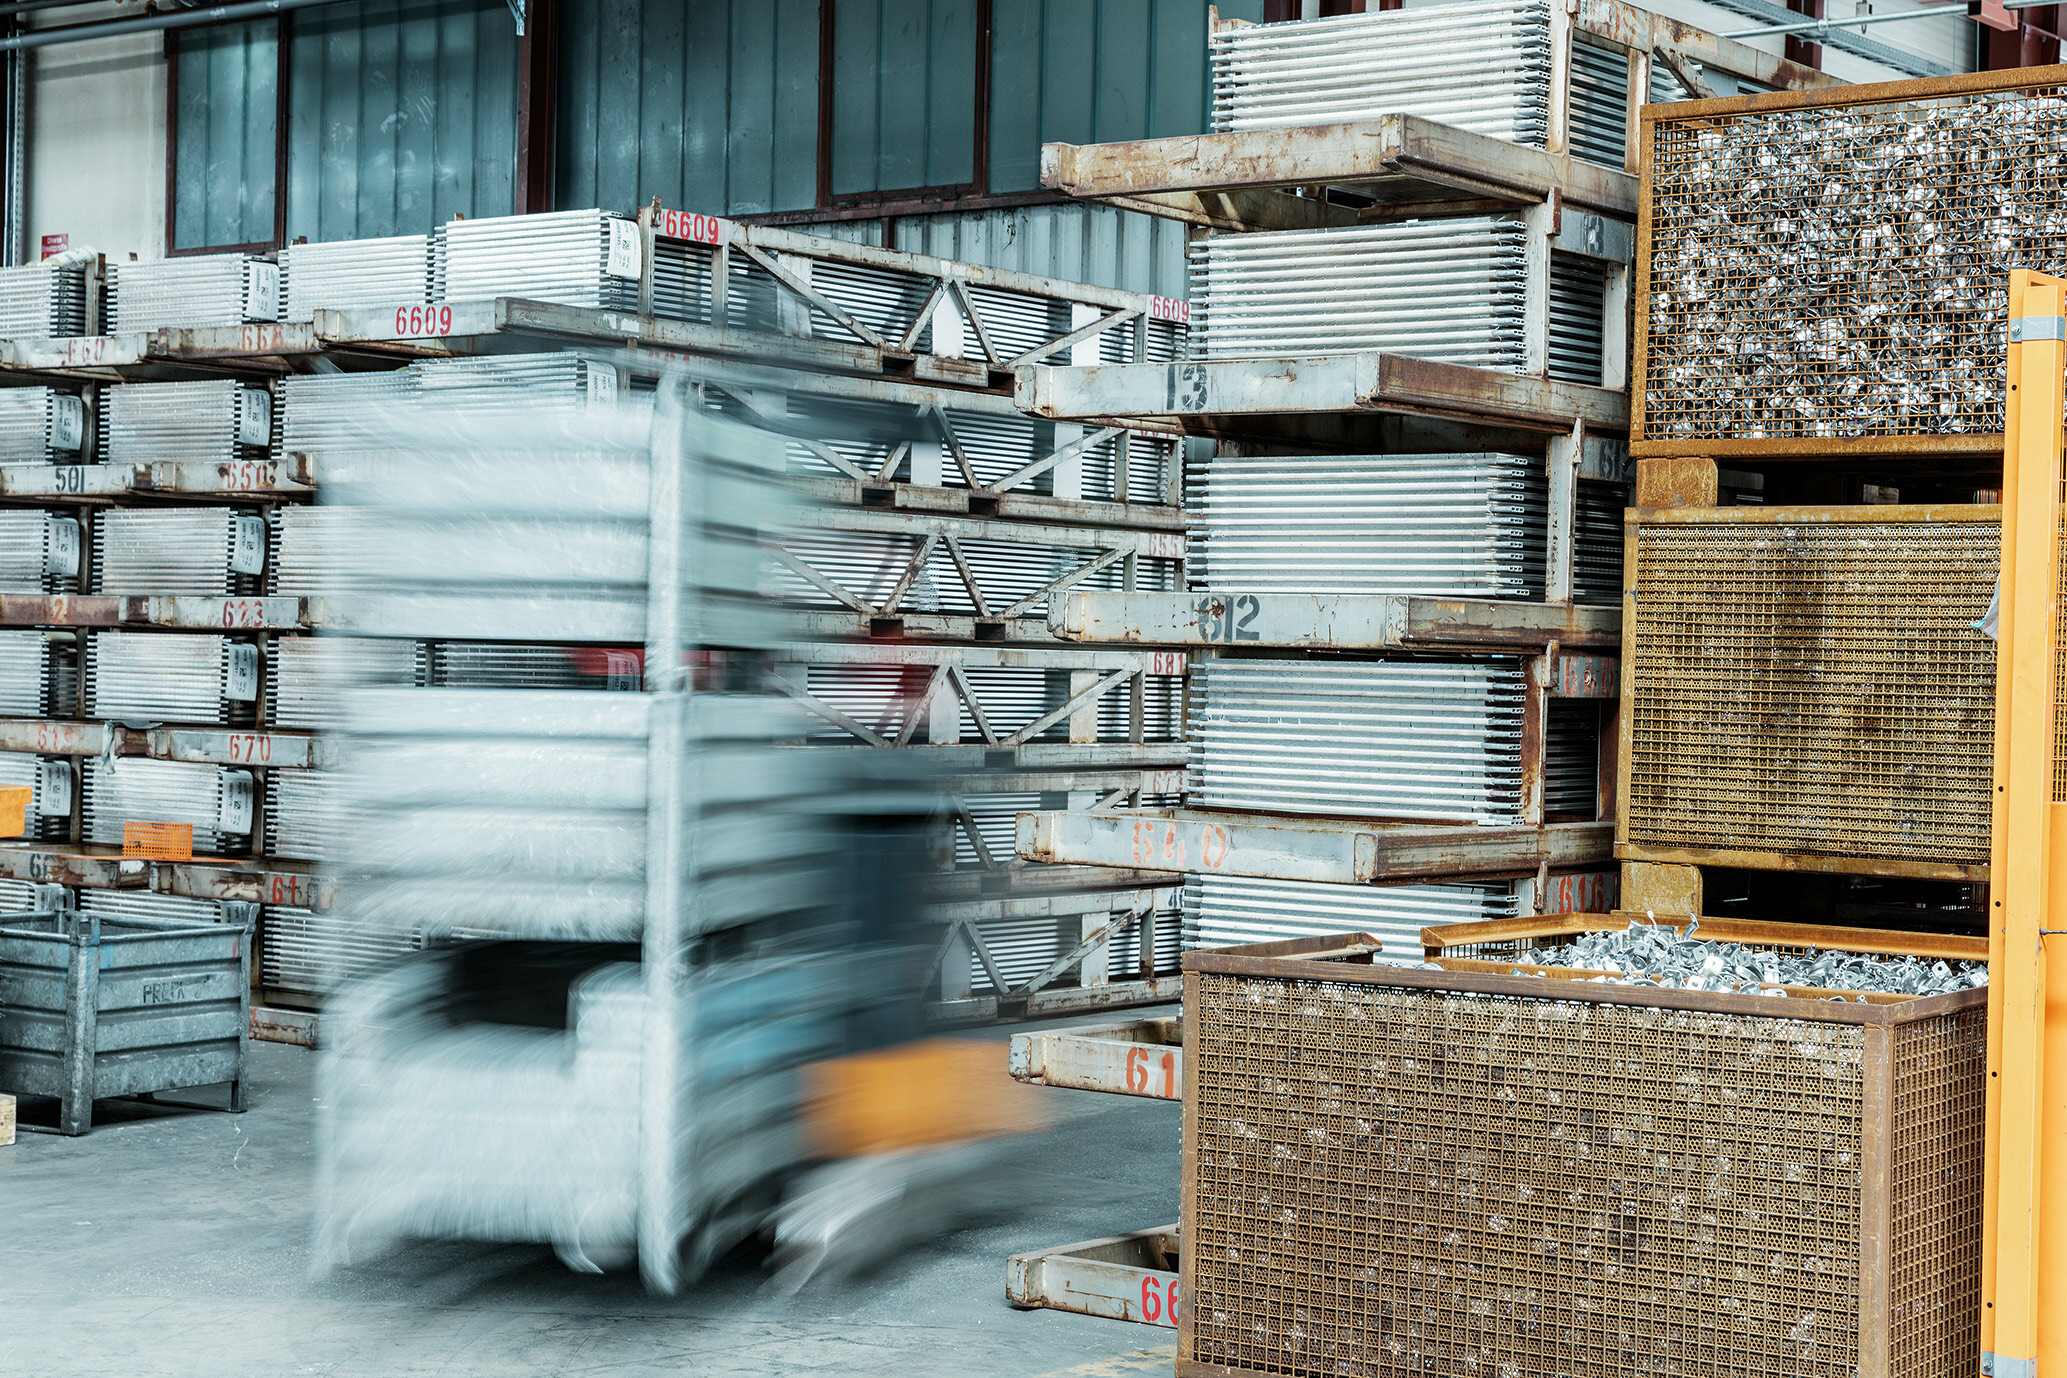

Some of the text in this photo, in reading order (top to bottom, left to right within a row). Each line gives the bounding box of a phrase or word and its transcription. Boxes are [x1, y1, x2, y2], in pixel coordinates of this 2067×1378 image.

[666, 208, 719, 245] 6609
[396, 305, 452, 336] 6609
[1152, 295, 1189, 324] 6609
[1166, 363, 1208, 411] 13
[55, 466, 86, 493] 501
[222, 600, 264, 628] 623
[1154, 651, 1184, 675] 681
[229, 734, 272, 763] 670
[1132, 819, 1227, 870] 640
[1559, 874, 1605, 914] 616
